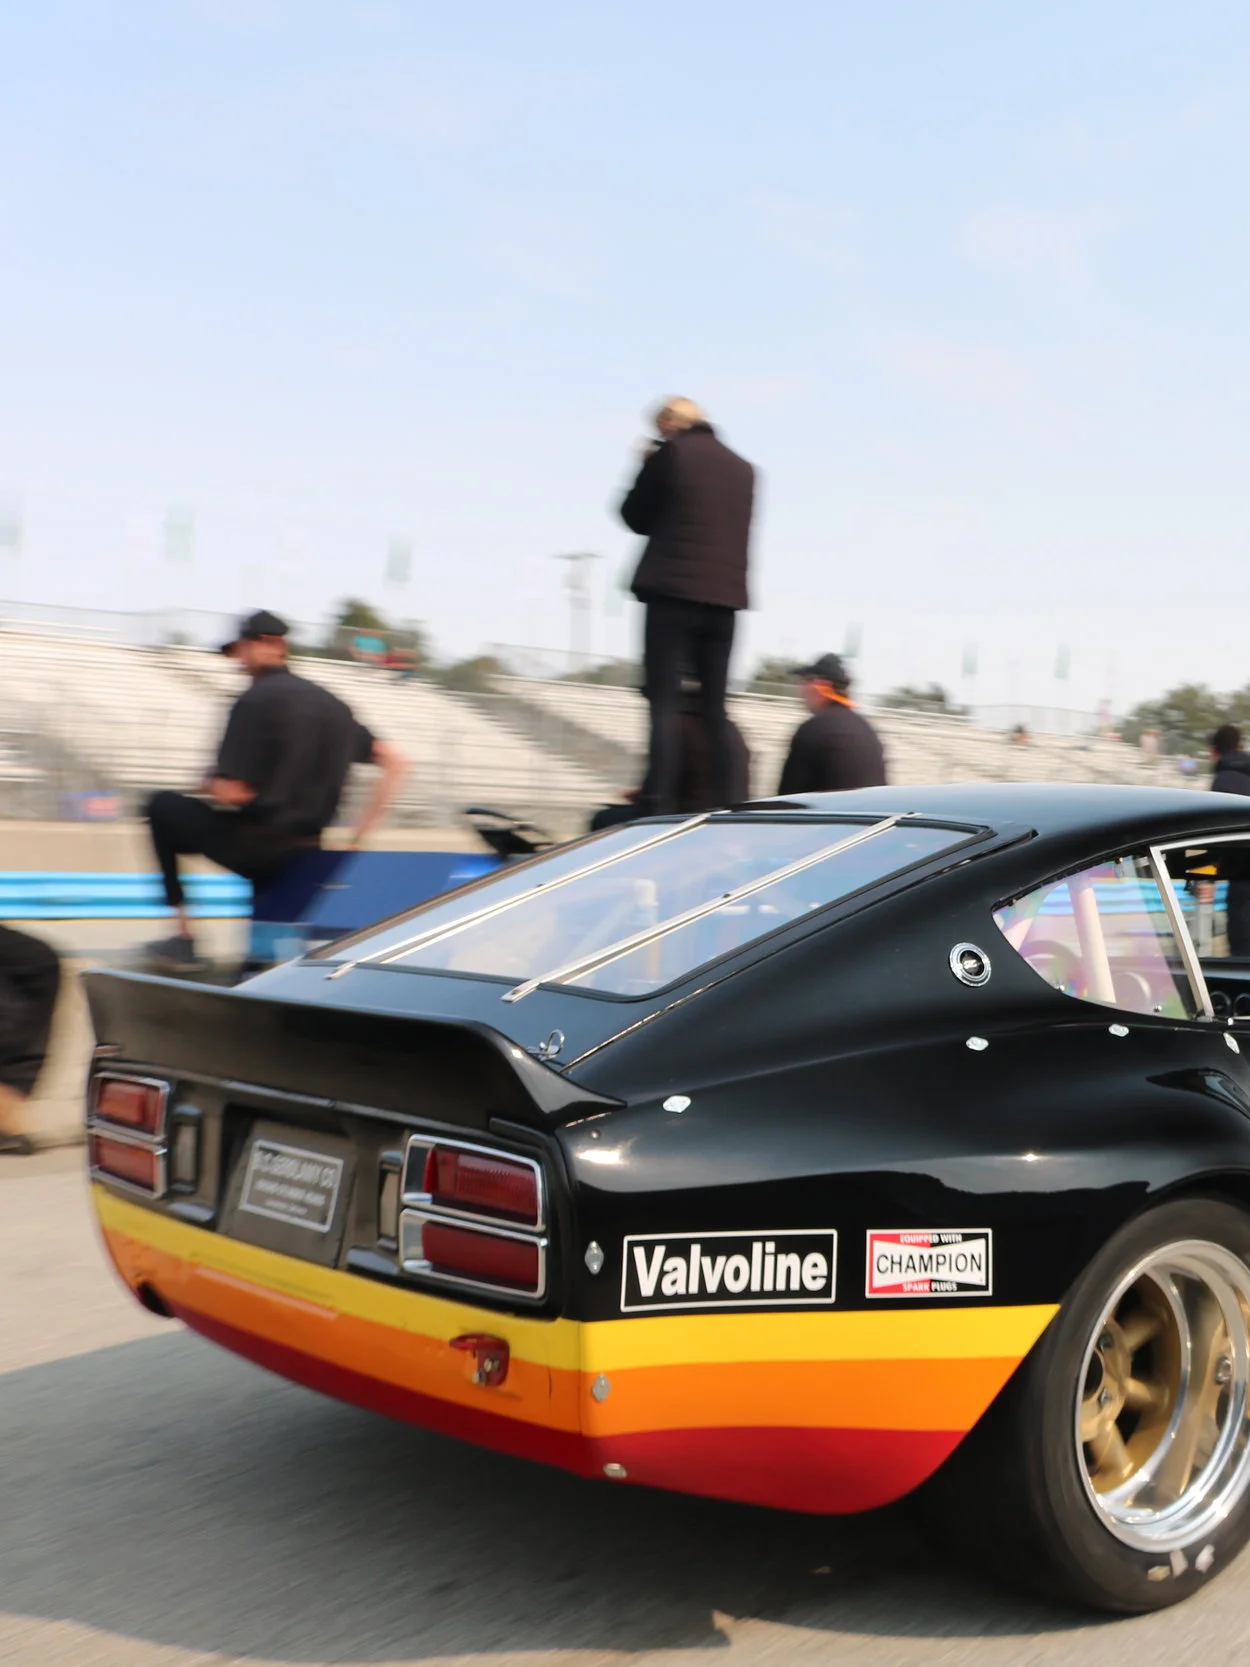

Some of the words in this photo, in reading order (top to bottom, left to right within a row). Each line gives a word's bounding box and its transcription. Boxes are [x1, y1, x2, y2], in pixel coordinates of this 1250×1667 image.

[900, 1233, 939, 1244] EQUIPPED
[940, 1233, 962, 1243] WITH
[632, 1240, 828, 1298] Valvoline
[876, 1252, 982, 1274] CHAMPION
[902, 1282, 929, 1292] SPARK
[931, 1281, 957, 1292] PLUGS
